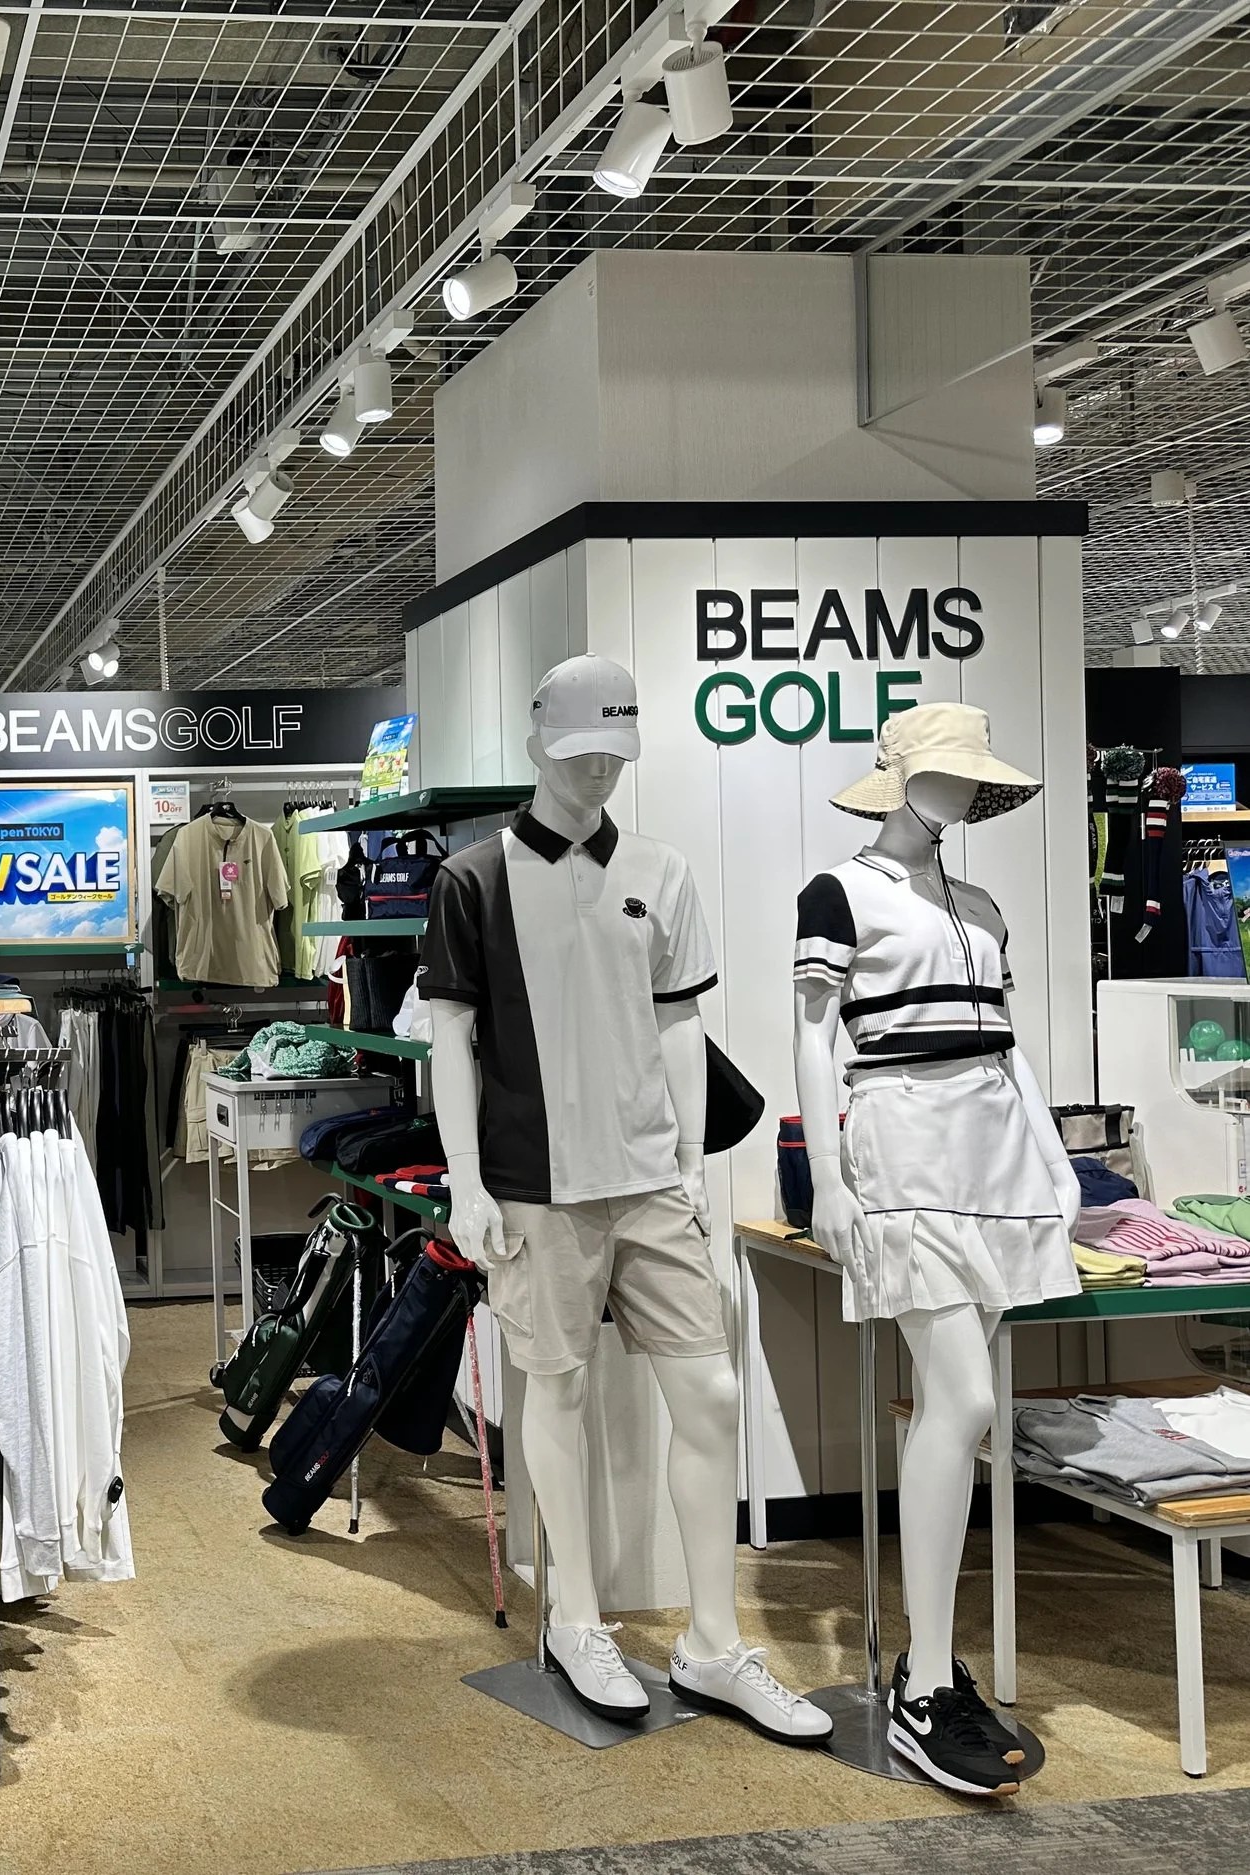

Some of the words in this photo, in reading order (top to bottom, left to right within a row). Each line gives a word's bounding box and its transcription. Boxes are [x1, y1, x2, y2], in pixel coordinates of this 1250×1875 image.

[695, 587, 985, 661] BEAMS
[694, 670, 923, 745] GOLF
[396, 872, 409, 883] GOLF
